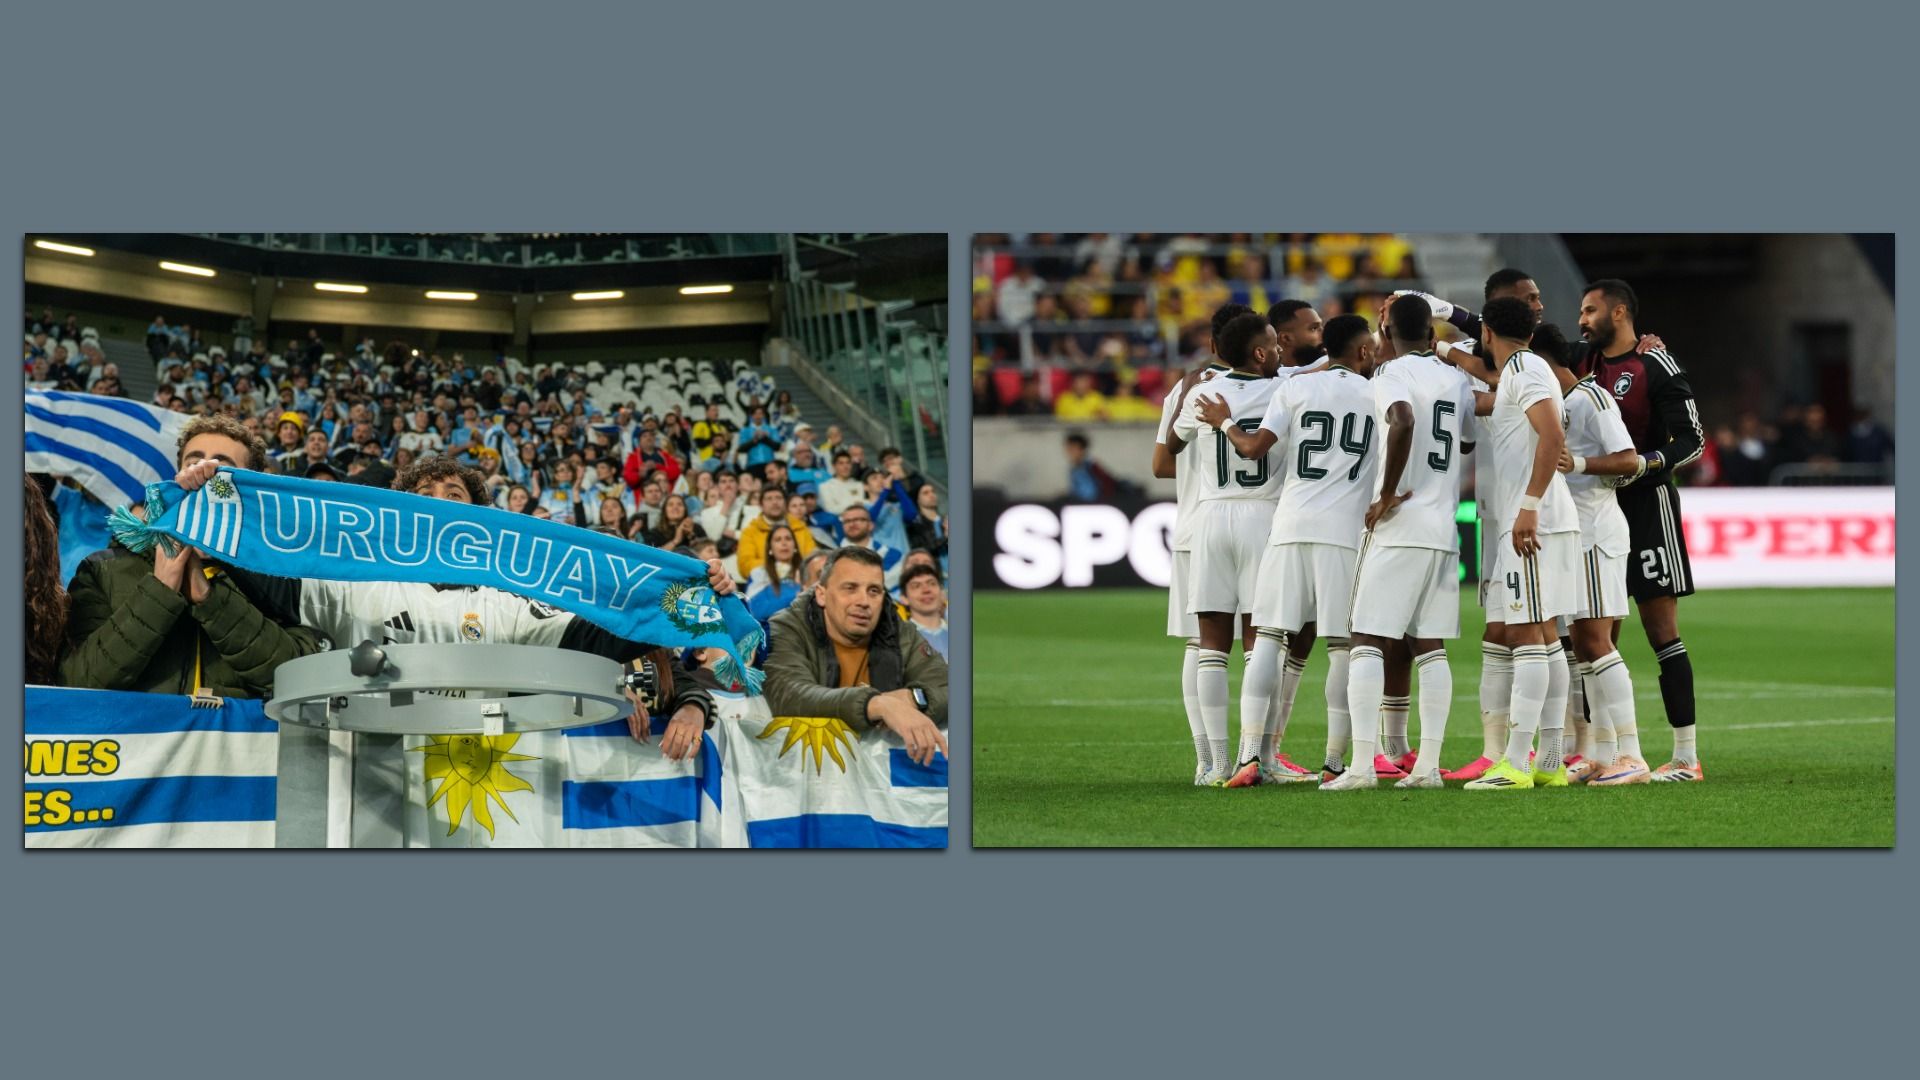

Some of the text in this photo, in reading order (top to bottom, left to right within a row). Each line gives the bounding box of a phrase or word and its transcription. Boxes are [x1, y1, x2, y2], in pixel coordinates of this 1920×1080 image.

[1296, 410, 1375, 482] 24
[1427, 399, 1456, 473] 5
[256, 489, 662, 611] URUGUAY
[1639, 546, 1669, 580] 21
[1506, 571, 1520, 600] 4
[25, 738, 120, 776] NES
